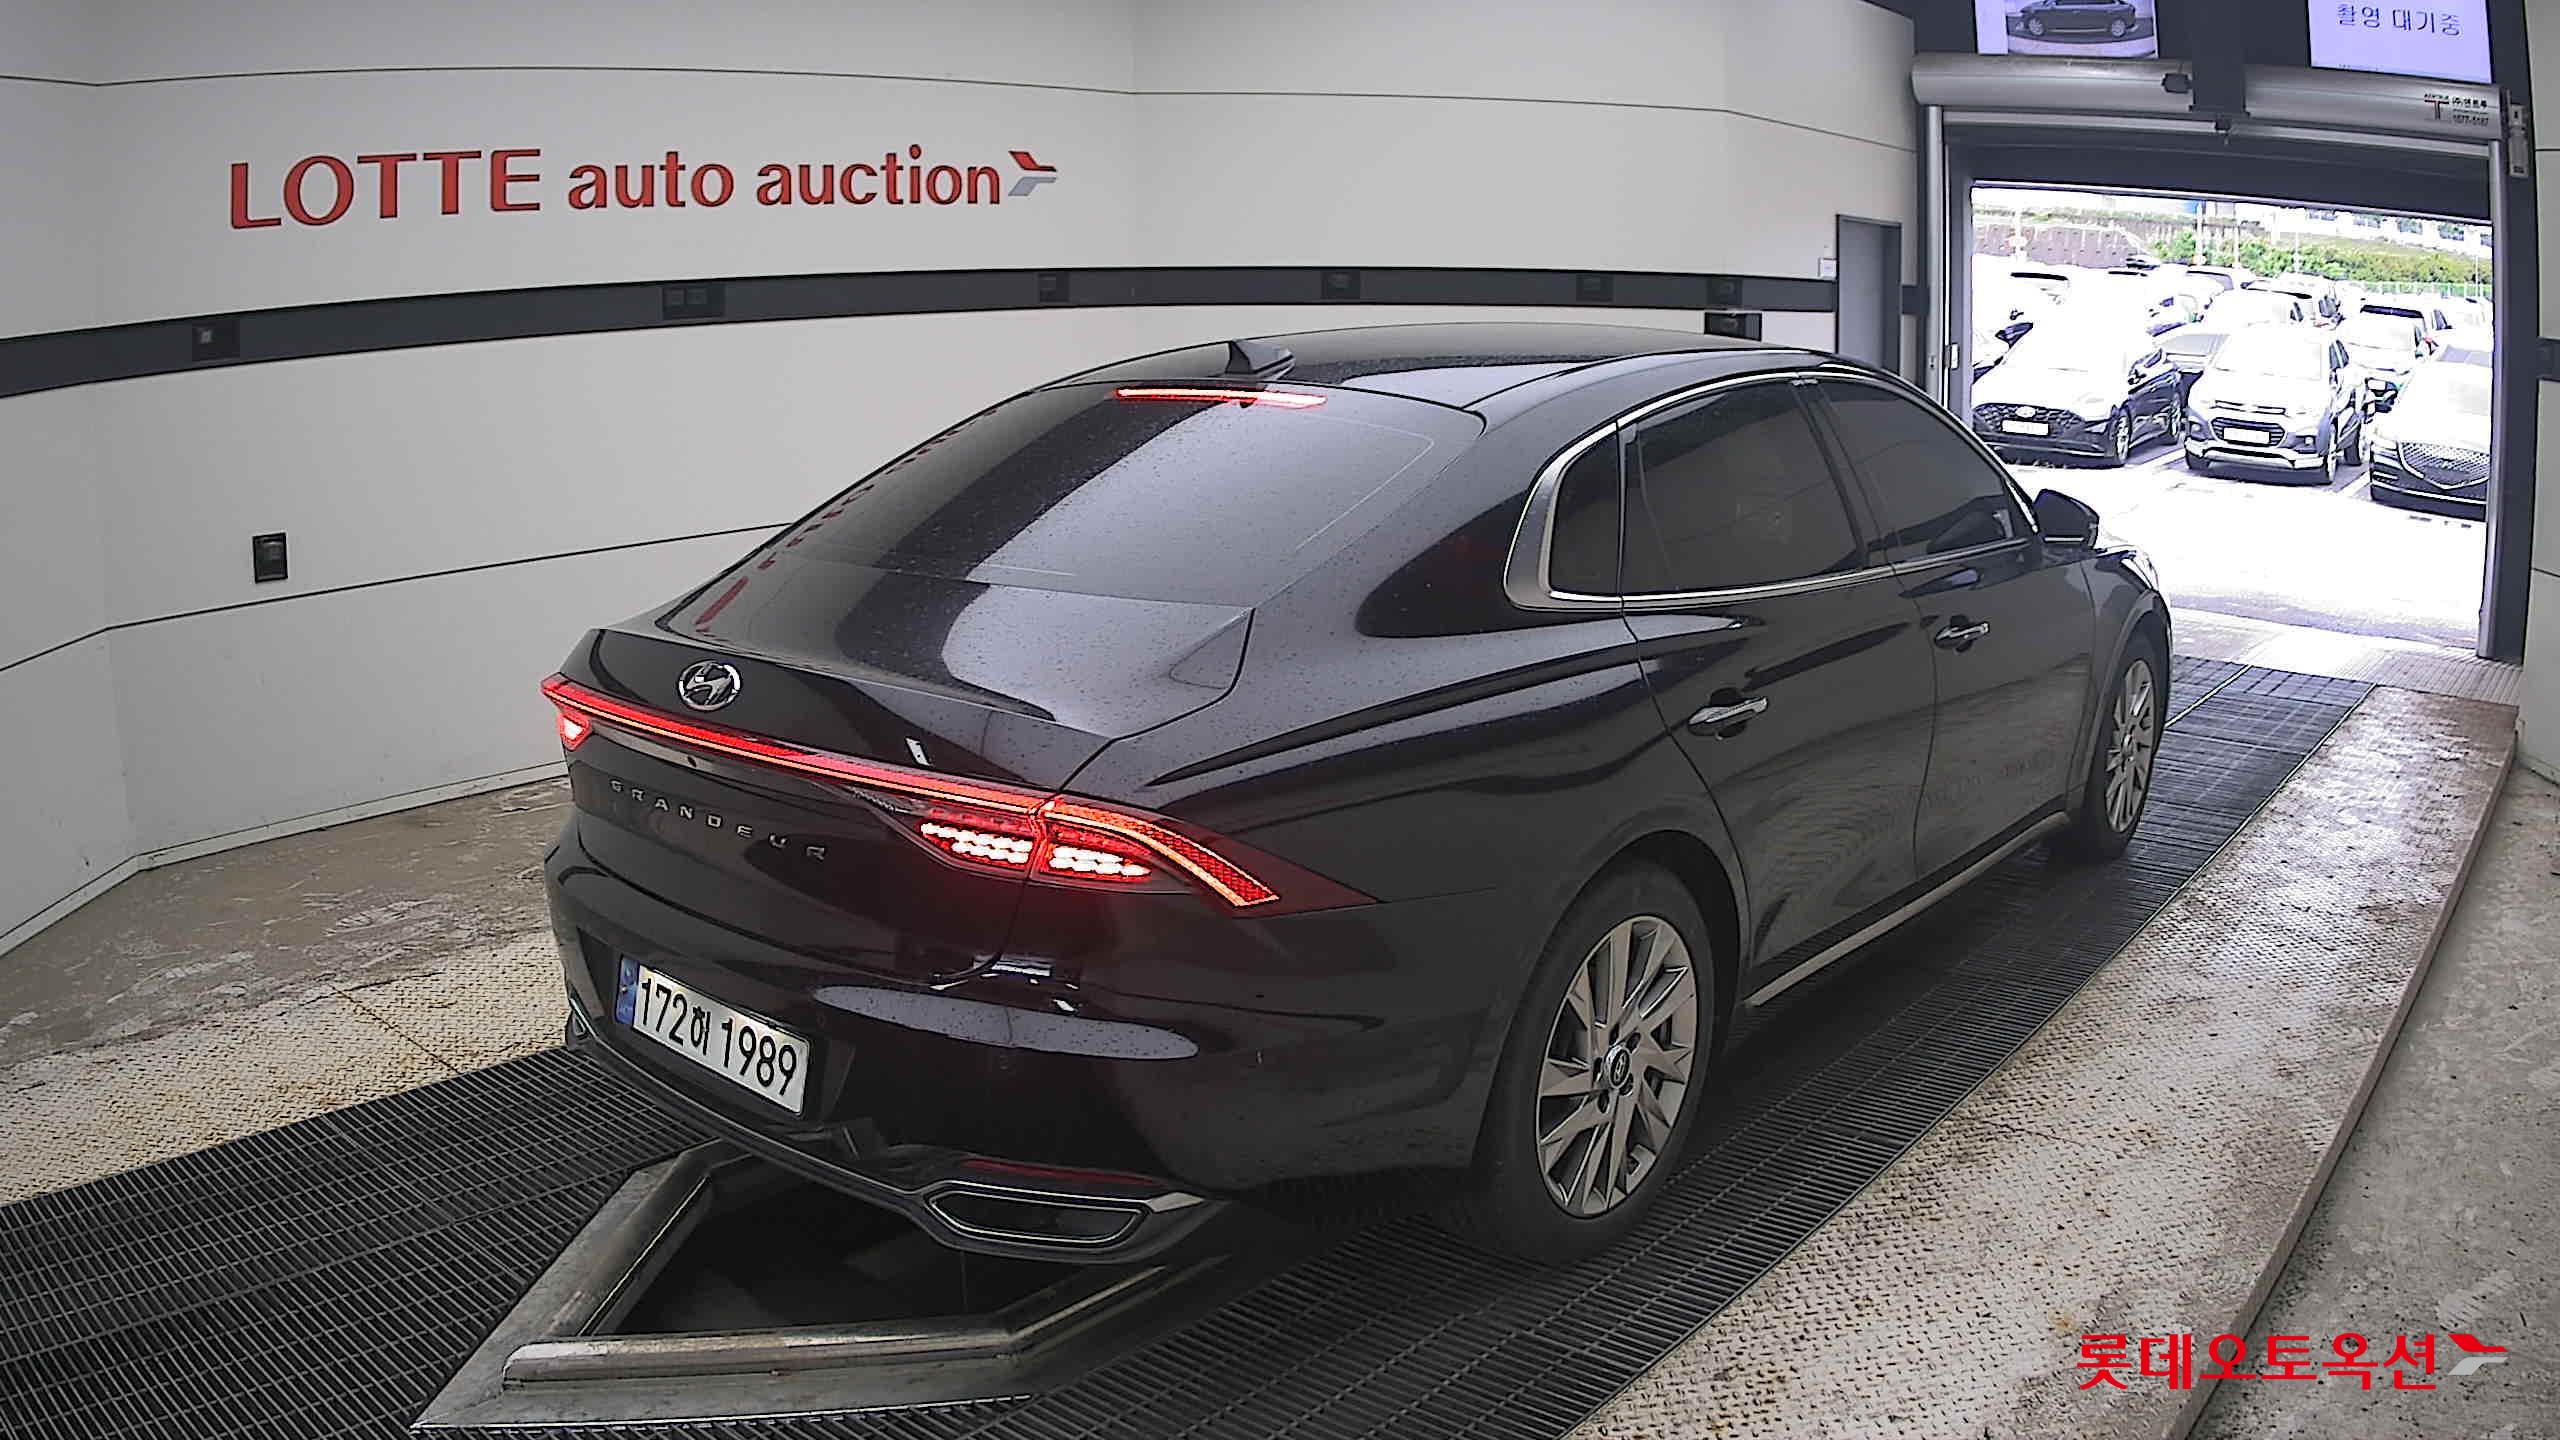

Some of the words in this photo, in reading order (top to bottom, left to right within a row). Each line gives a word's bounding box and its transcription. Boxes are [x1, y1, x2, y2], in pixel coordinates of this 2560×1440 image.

[2337, 4, 2381, 28] 촬영
[2392, 9, 2460, 36] 대기중
[230, 149, 541, 229] LOTTE
[568, 151, 735, 208] auto
[756, 145, 1001, 205] auction
[610, 780, 826, 860] GRANDEUR
[642, 978, 711, 1056] 172허
[721, 1017, 797, 1096] 1989
